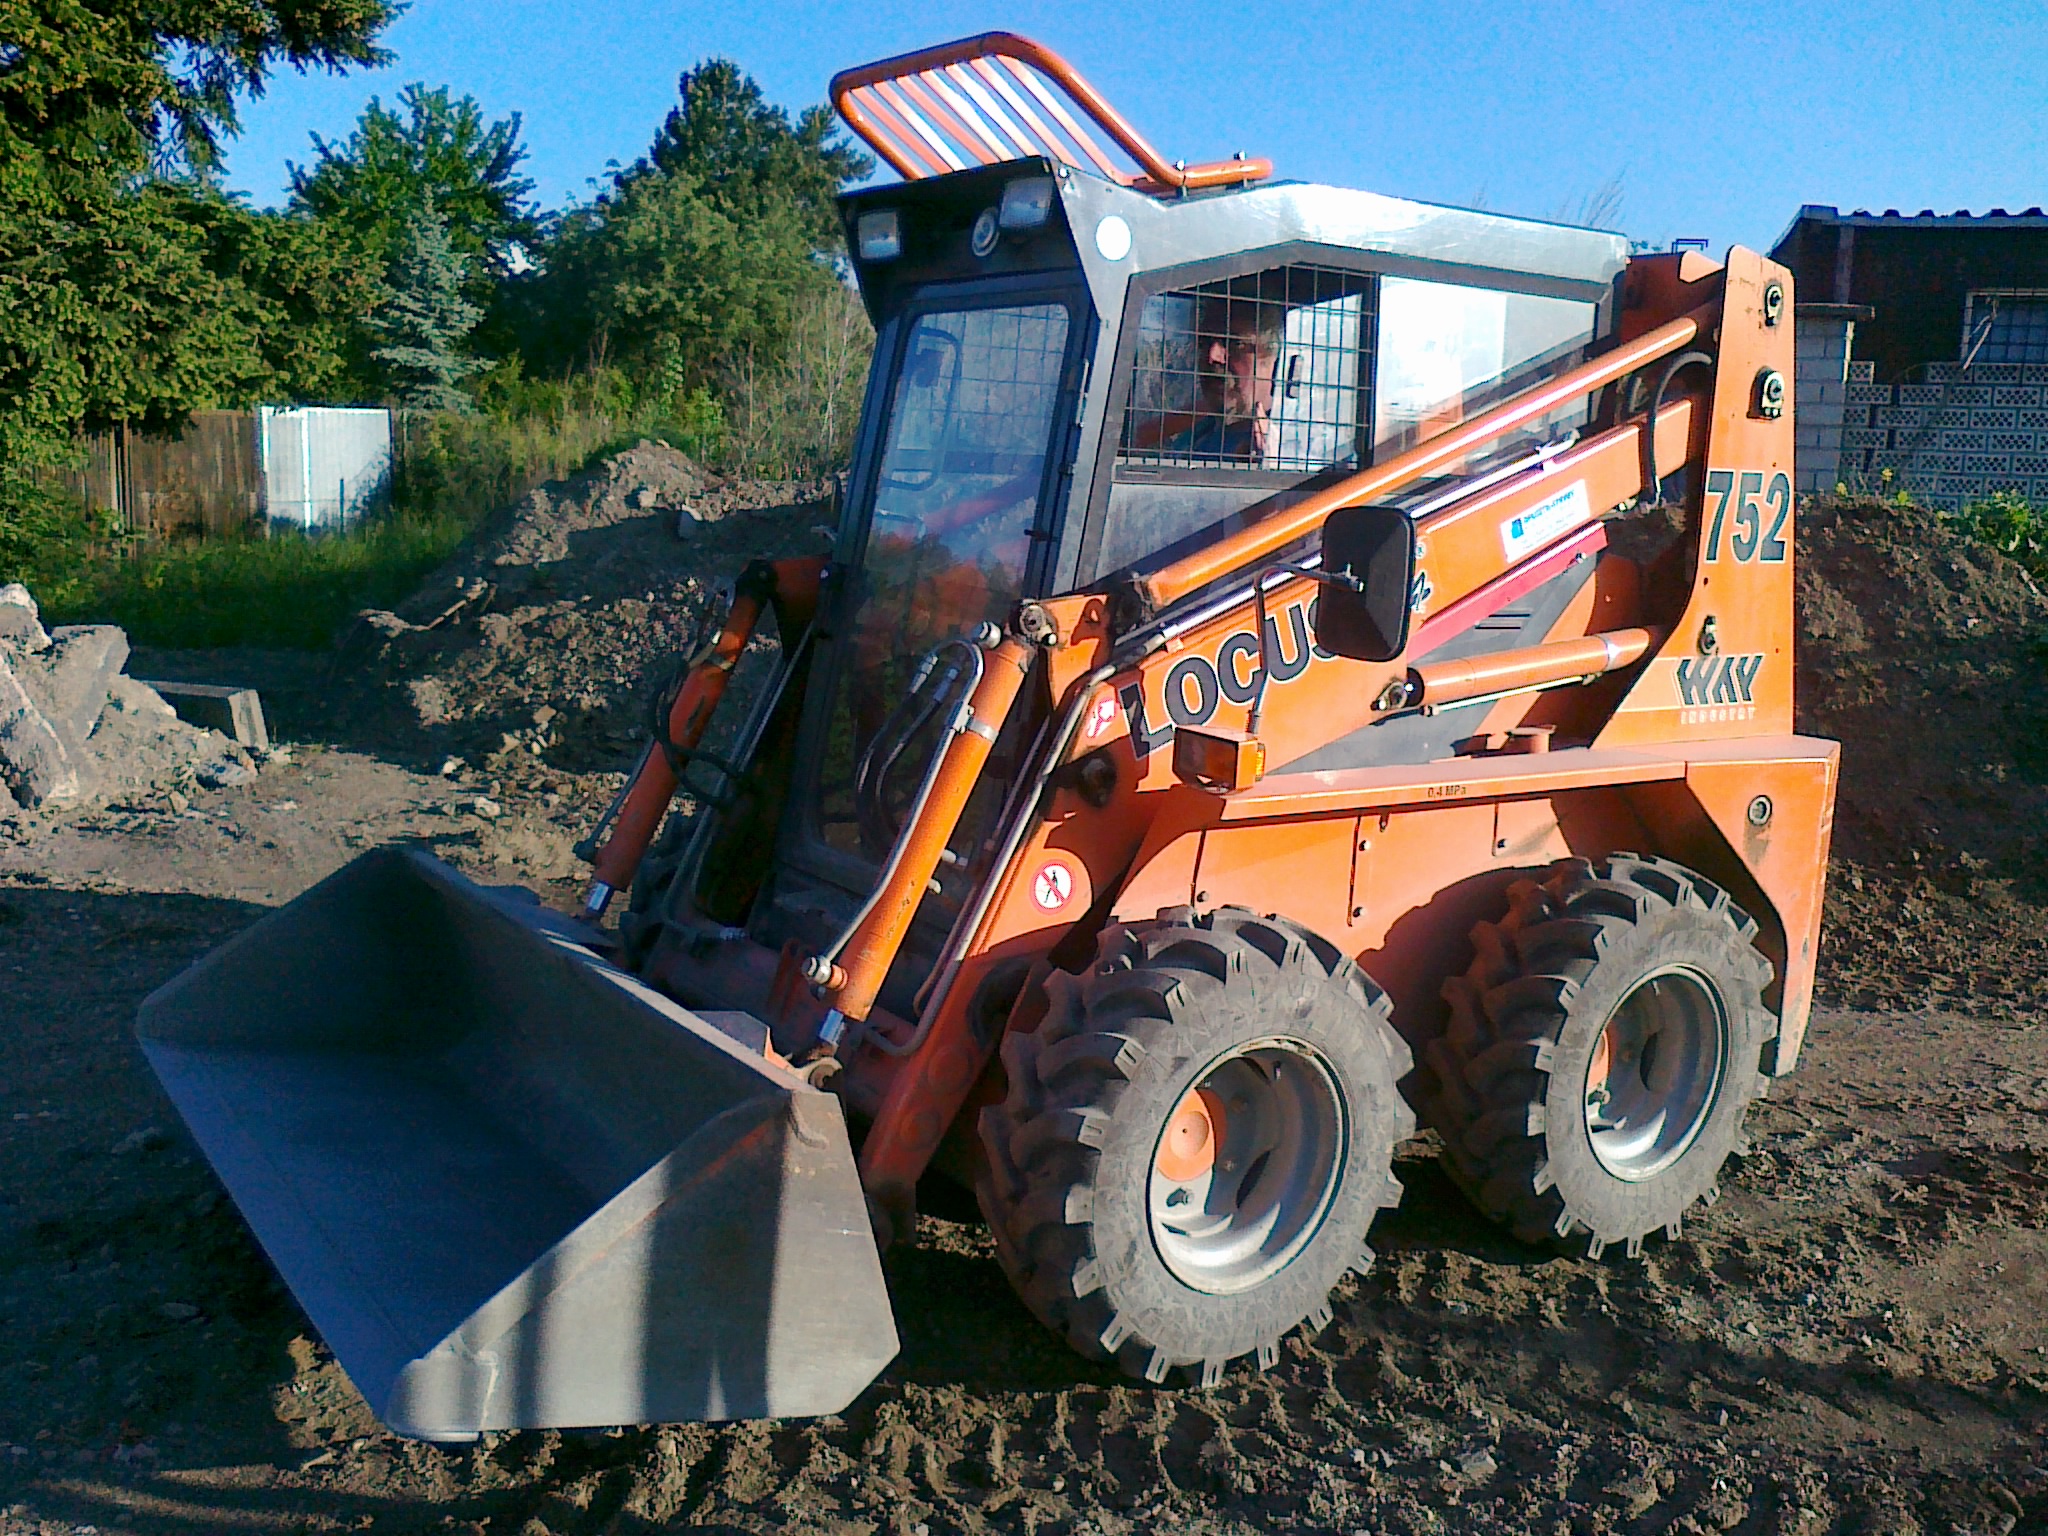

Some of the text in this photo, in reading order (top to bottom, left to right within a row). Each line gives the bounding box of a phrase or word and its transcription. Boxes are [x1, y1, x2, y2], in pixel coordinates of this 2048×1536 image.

[1705, 470, 1790, 563] 752
[1119, 595, 1337, 760] LOCU
[1676, 654, 1764, 706] WAY
